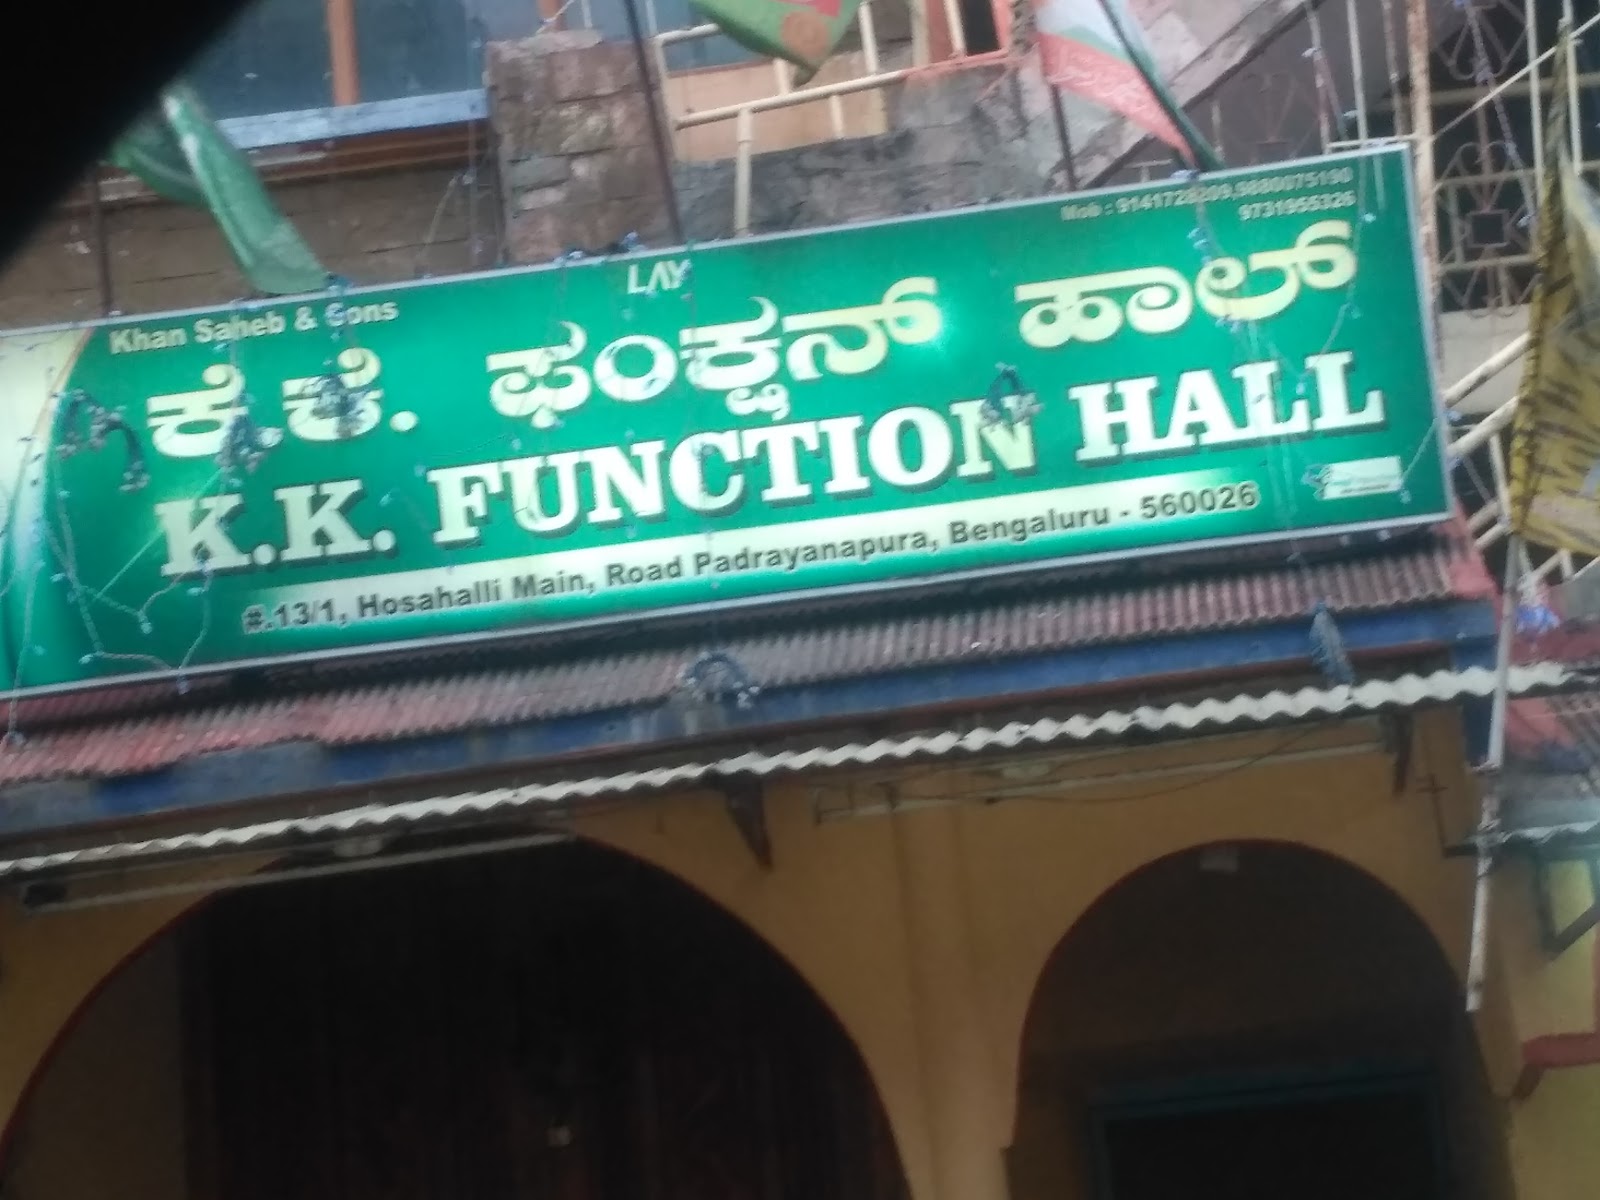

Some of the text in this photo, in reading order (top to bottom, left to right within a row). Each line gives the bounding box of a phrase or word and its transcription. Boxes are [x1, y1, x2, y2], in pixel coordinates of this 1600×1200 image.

[109, 301, 400, 355] Khan Saheb & Sons
[486, 276, 943, 429] ಫಂಕ್ಷನ್
[1014, 219, 1357, 348] ಹಾಲ್
[154, 350, 1388, 577] K.K. FUNCTION HALL
[357, 575, 501, 619] Hosahalli
[511, 570, 595, 599] Main,
[604, 555, 683, 587] Road
[693, 529, 940, 571] Padrayanapura,
[948, 505, 1110, 543] Bengaluru
[1139, 481, 1260, 521] 560026
